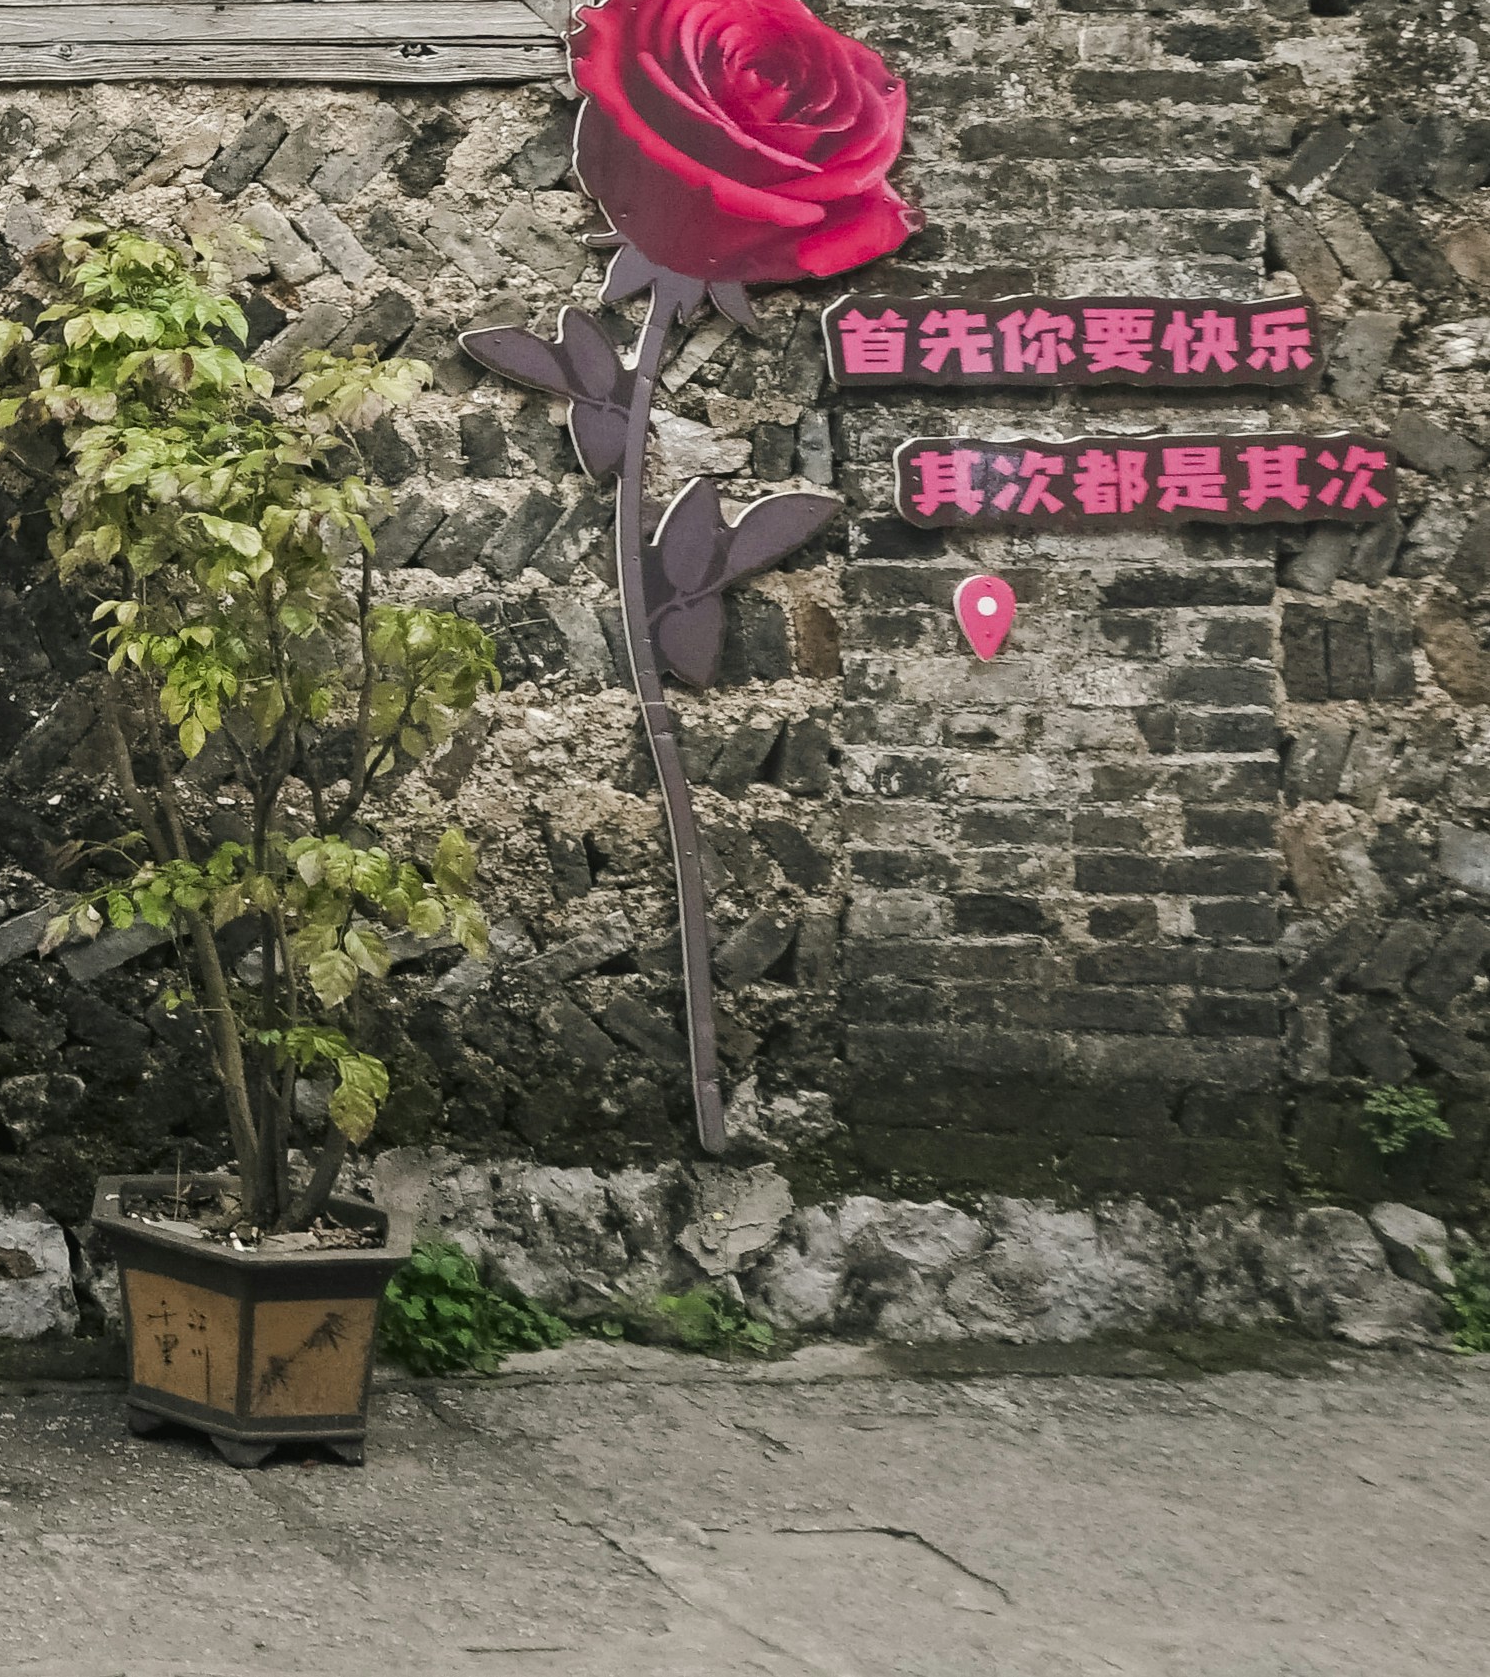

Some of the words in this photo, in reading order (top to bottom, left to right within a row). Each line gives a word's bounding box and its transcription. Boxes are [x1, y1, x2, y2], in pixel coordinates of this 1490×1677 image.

[838, 306, 1314, 375] 首先你要快乐
[910, 444, 1390, 517] 其次都是其次
